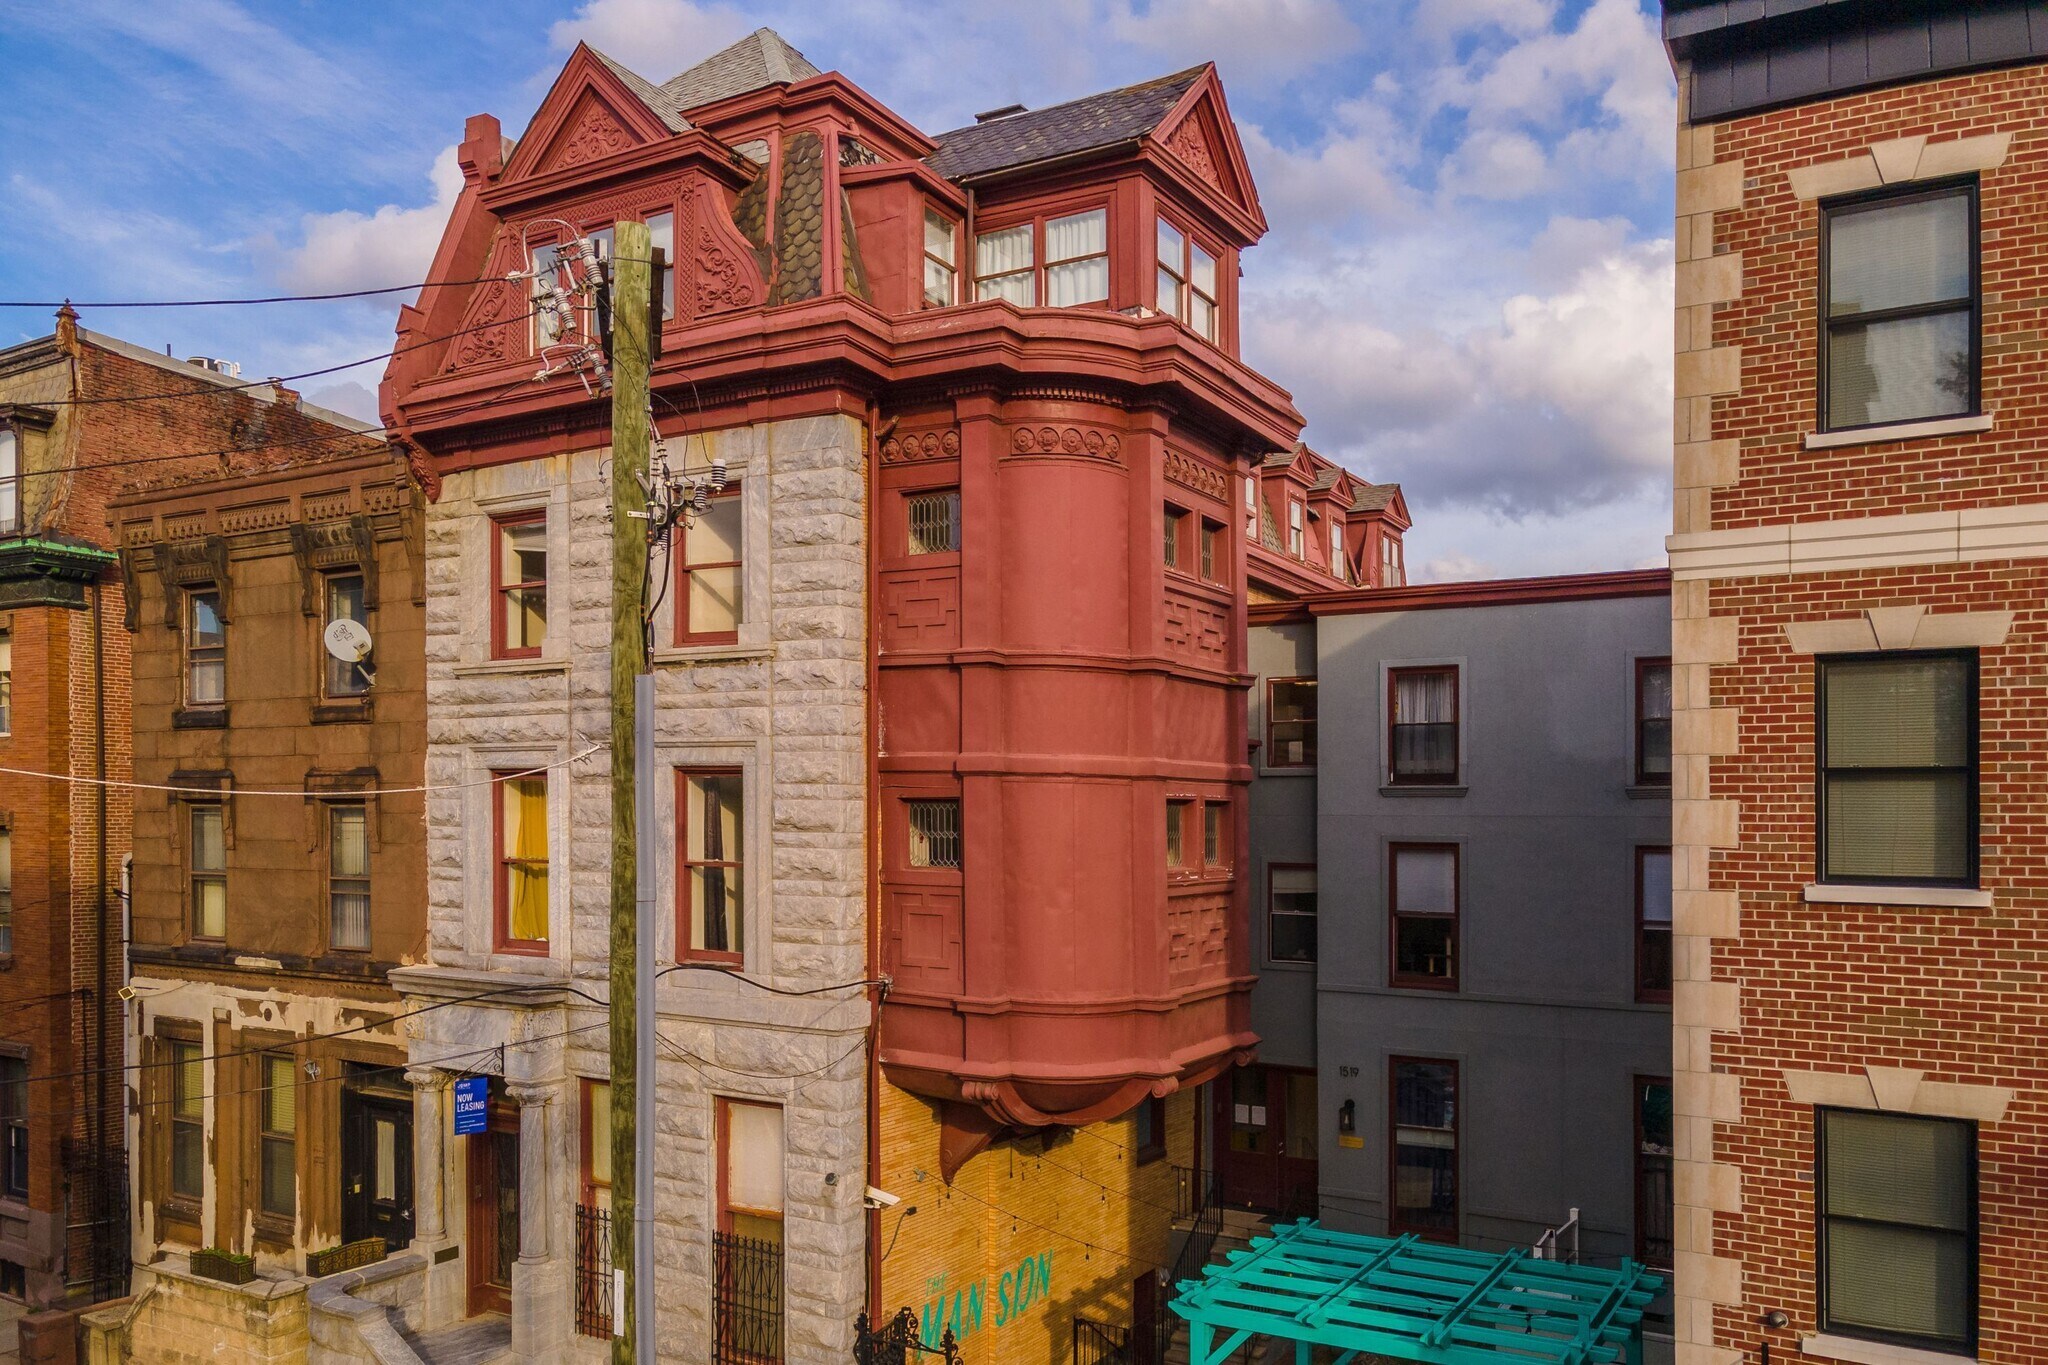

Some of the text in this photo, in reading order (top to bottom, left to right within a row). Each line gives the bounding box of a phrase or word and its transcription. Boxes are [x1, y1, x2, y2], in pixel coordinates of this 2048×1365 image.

[1339, 1065, 1359, 1078] 1519
[457, 1093, 473, 1103] NOW
[457, 1101, 485, 1113] LEASING
[917, 1248, 1054, 1361] MANSION
